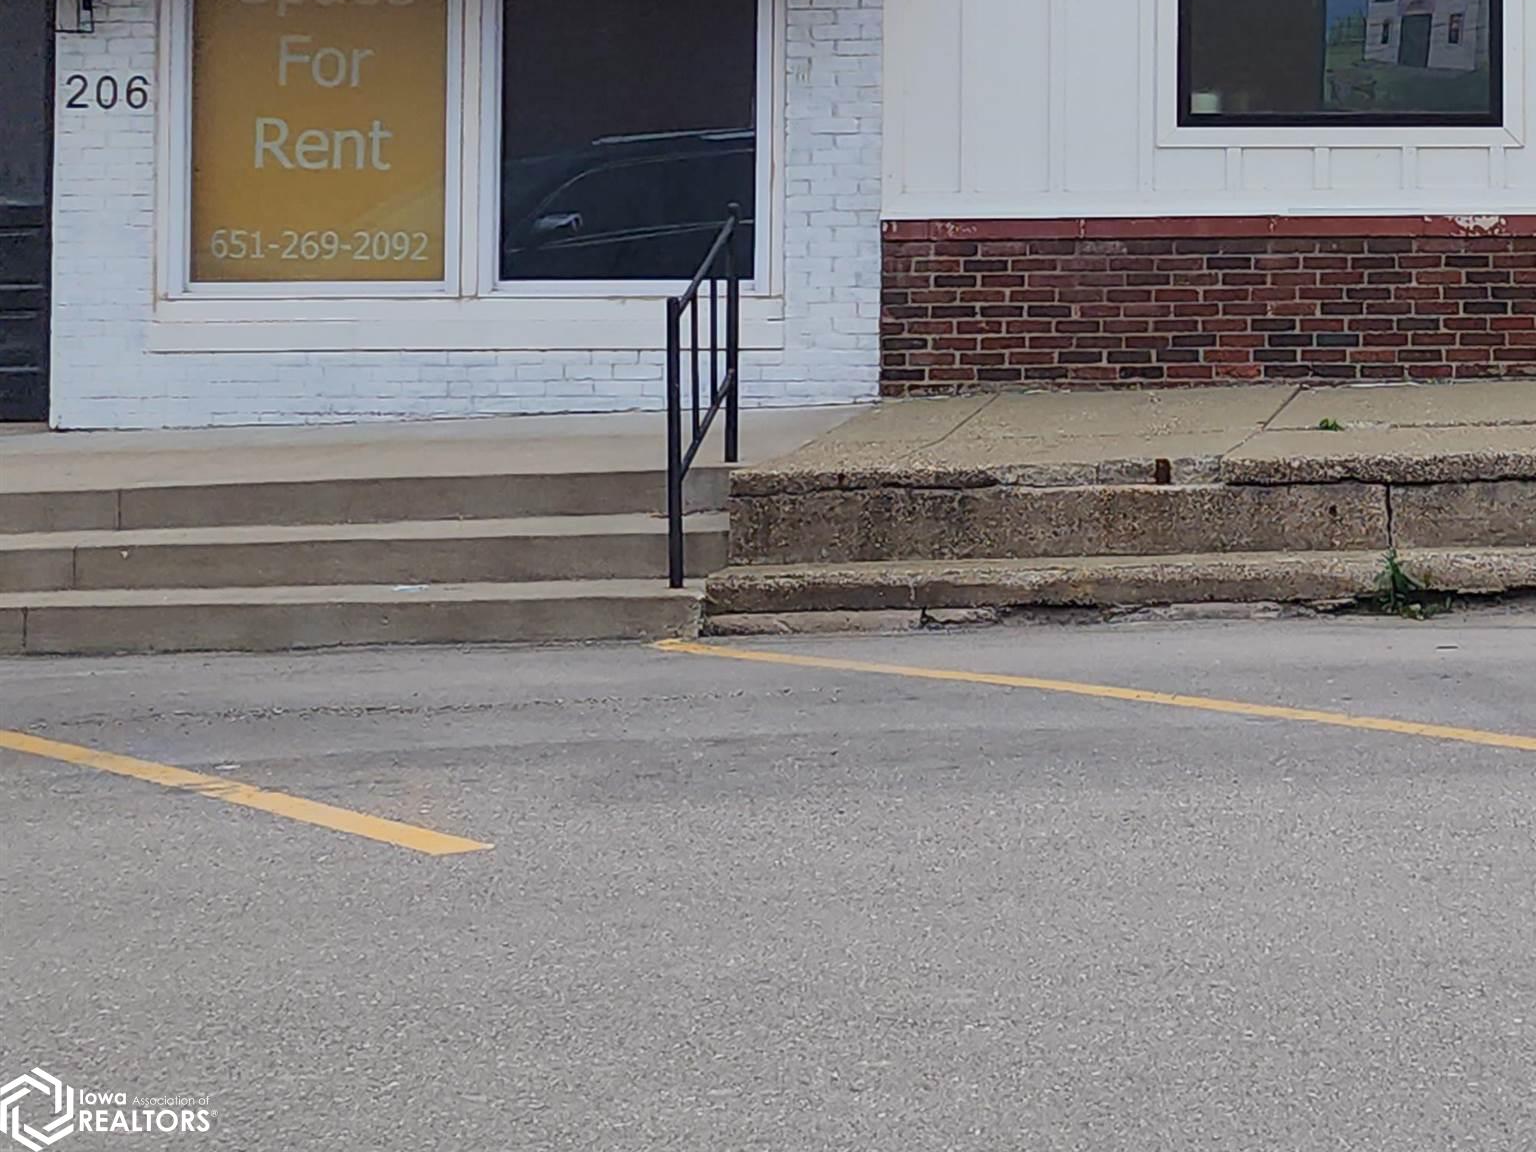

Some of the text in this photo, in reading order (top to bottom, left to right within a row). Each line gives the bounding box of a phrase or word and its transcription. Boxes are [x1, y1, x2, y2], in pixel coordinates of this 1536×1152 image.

[278, 34, 375, 88] For
[65, 74, 150, 110] 206
[255, 117, 393, 171] Rent
[210, 229, 429, 261] 651-269-2092
